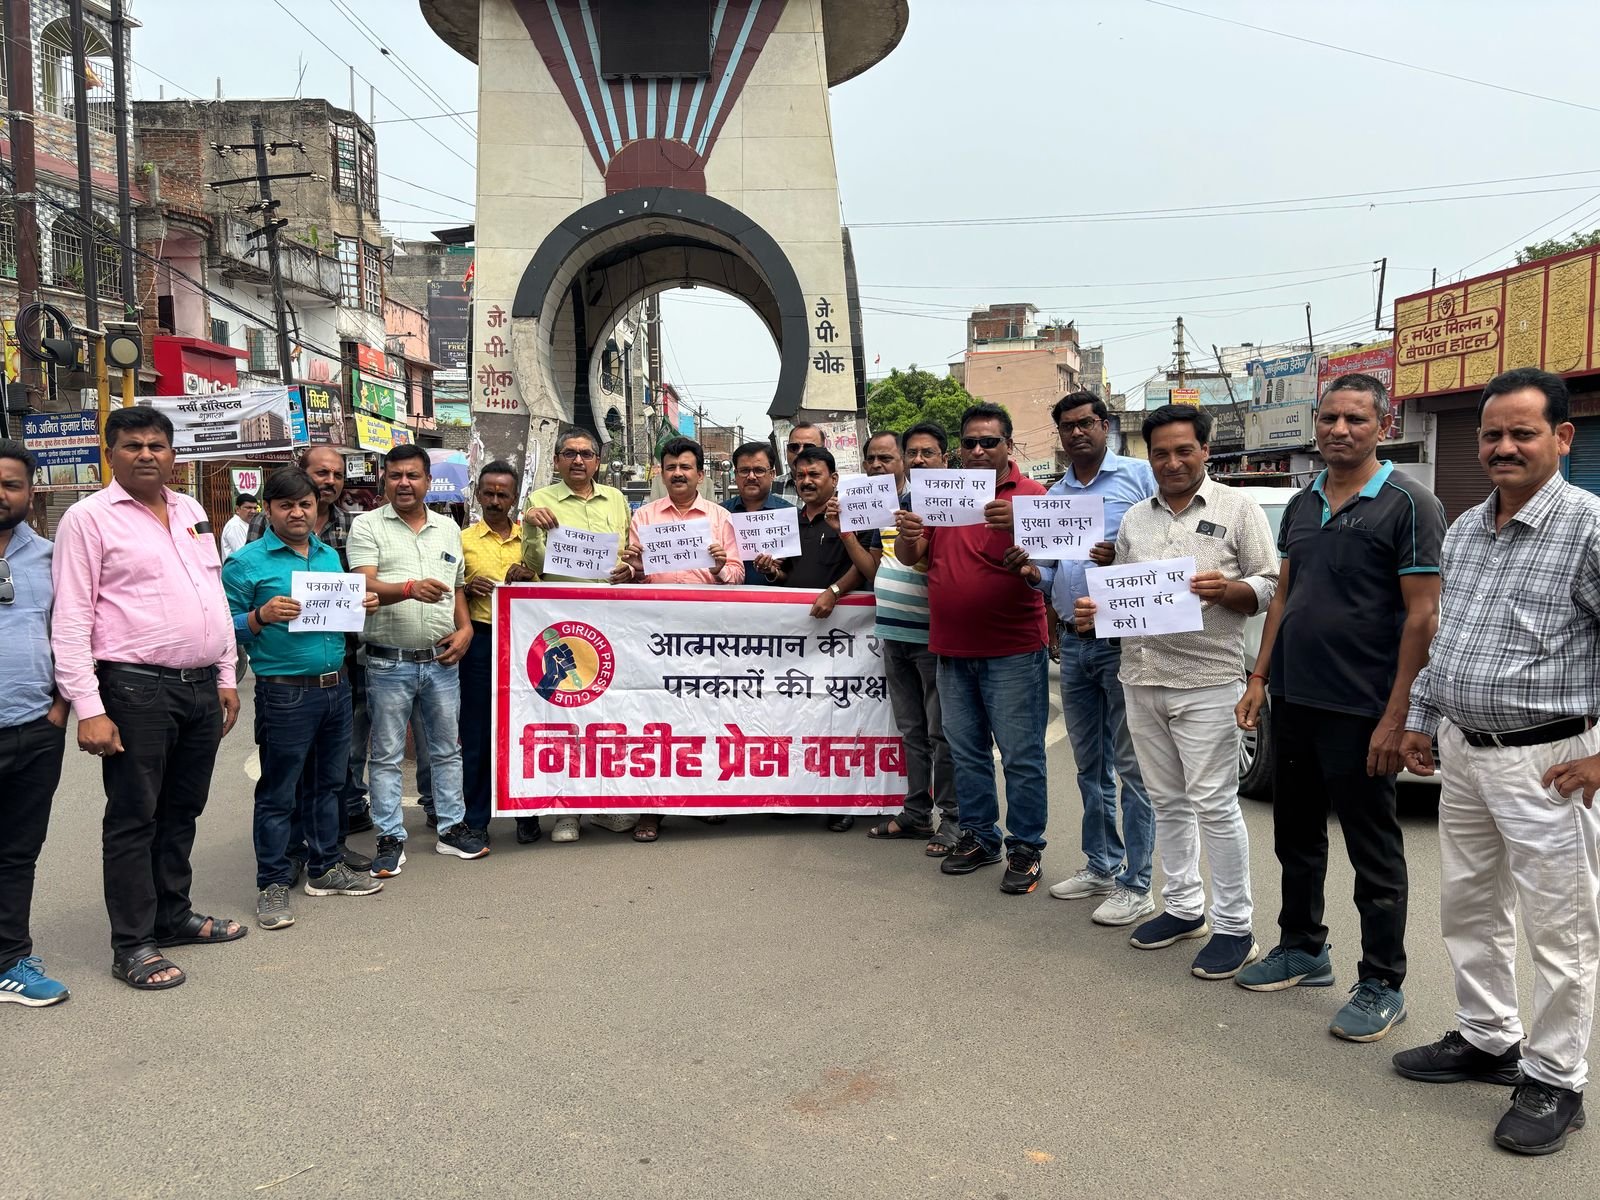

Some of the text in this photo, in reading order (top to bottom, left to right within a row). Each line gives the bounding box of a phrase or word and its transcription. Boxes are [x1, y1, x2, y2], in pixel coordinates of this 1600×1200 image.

[815, 297, 834, 318] जे.
[815, 320, 838, 343] पी.
[1411, 316, 1482, 343] मधुर मिलन
[813, 350, 845, 373] चौक
[477, 364, 513, 387] चौक
[200, 399, 242, 413] हॉस्पिटल
[38, 420, 59, 434] अमित
[60, 420, 80, 436] कुमार
[1032, 461, 1050, 471] cozi
[846, 482, 889, 496] पत्रकारों पर
[924, 476, 986, 490] पत्रकारों पर
[847, 498, 883, 511] हमला बंद
[925, 495, 975, 508] हमला बंद
[1032, 499, 1071, 509] पत्रकार
[746, 513, 775, 523] पत्रकार
[1021, 517, 1092, 532] सुरक्षा कानून
[565, 529, 595, 542] पत्रकार
[655, 523, 687, 534] पत्रकार
[739, 524, 790, 539] सुरक्षा कानून
[646, 536, 703, 553] सुरक्षा कानून
[741, 542, 759, 553] लागू
[1021, 536, 1048, 549] लागू
[552, 541, 609, 559] सुरक्षा कानून
[551, 555, 572, 568] लागू
[648, 554, 671, 564] लागू
[306, 580, 360, 592] पत्रकारों पर
[1105, 569, 1185, 589] पत्रकारों पर
[305, 597, 351, 609] हमला बंद
[1108, 591, 1174, 610] हमला बंद
[646, 628, 885, 658] आत्मसम्मान की र
[555, 624, 612, 705] GIRIDIH PRESS CLUB
[663, 668, 887, 708] पत्रकारों की सुरक्ष
[519, 722, 908, 781] गिरिडीह प्रेस क्लब
